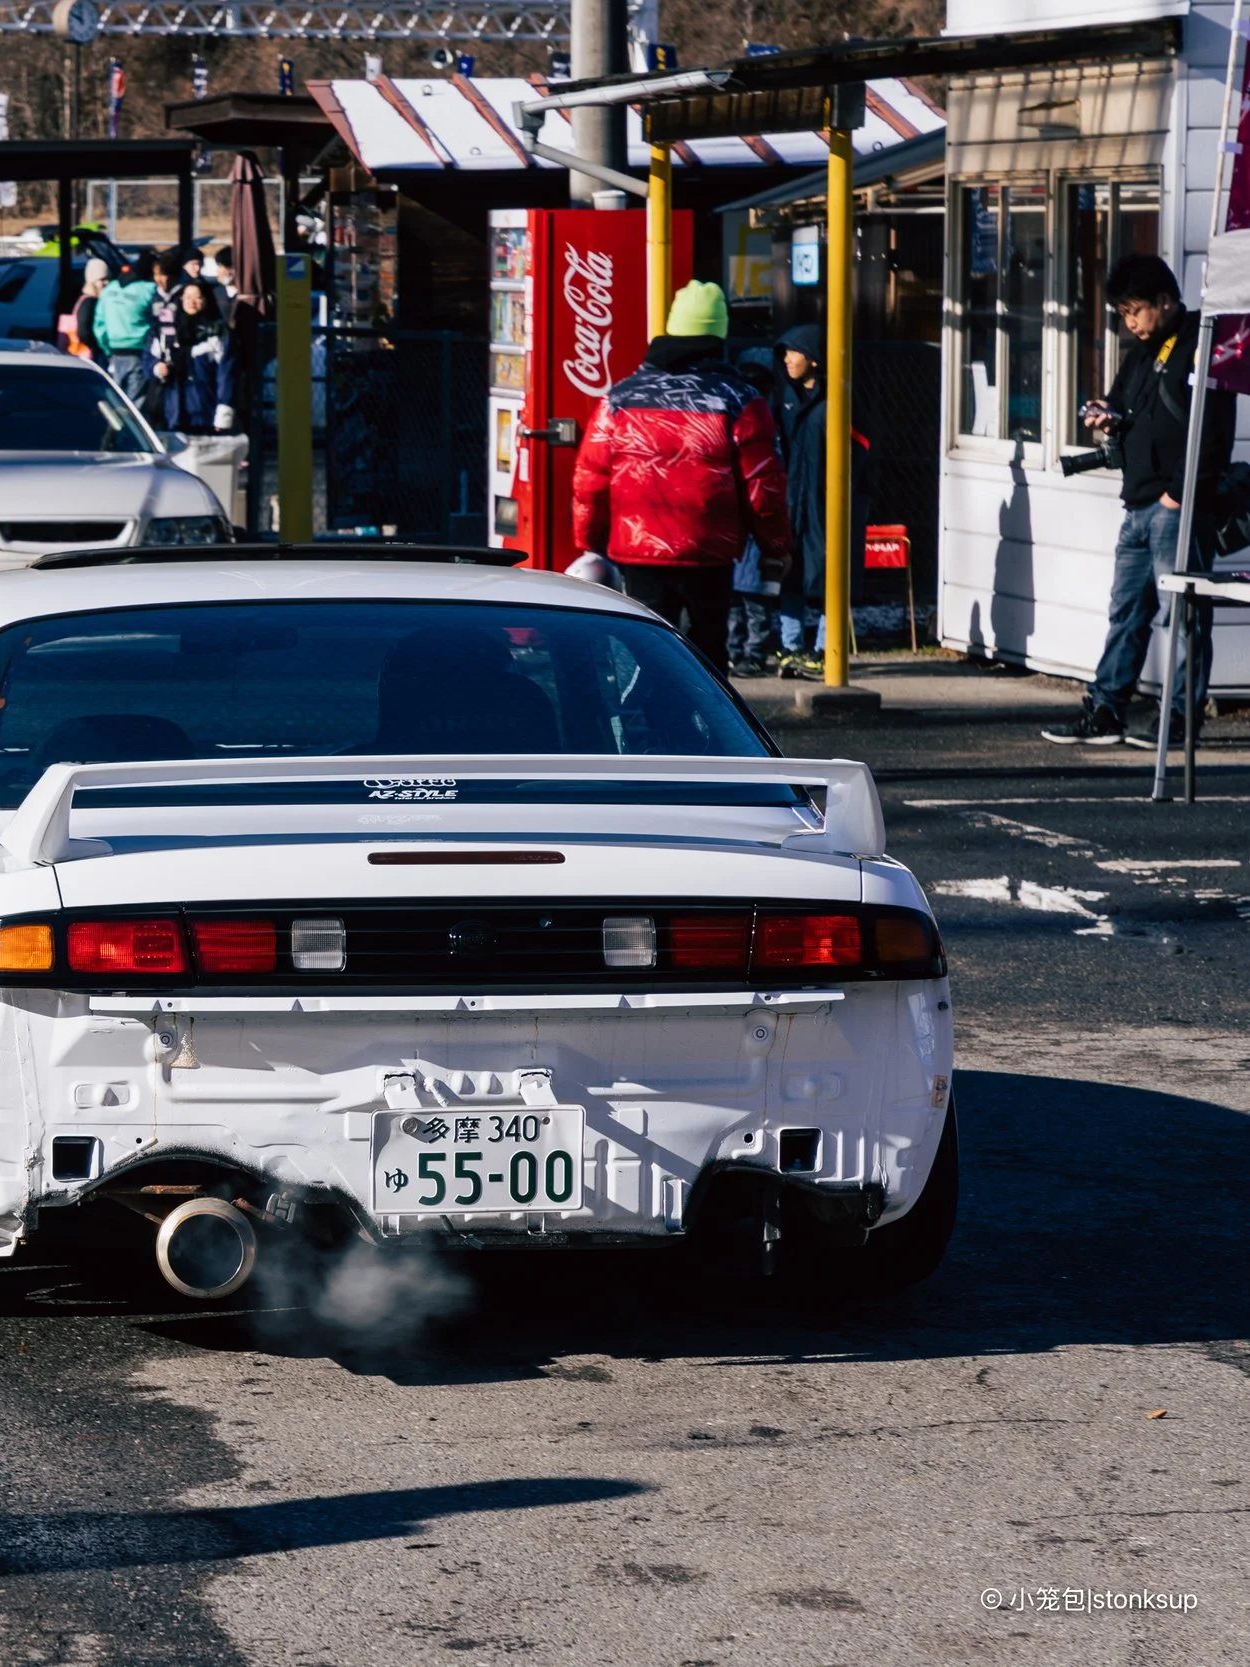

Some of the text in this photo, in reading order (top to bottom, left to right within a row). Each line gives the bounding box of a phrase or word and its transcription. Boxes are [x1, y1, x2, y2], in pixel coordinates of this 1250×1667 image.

[422, 1115, 538, 1144] 多摩 340
[384, 1149, 574, 1206] ゆ 55-00
